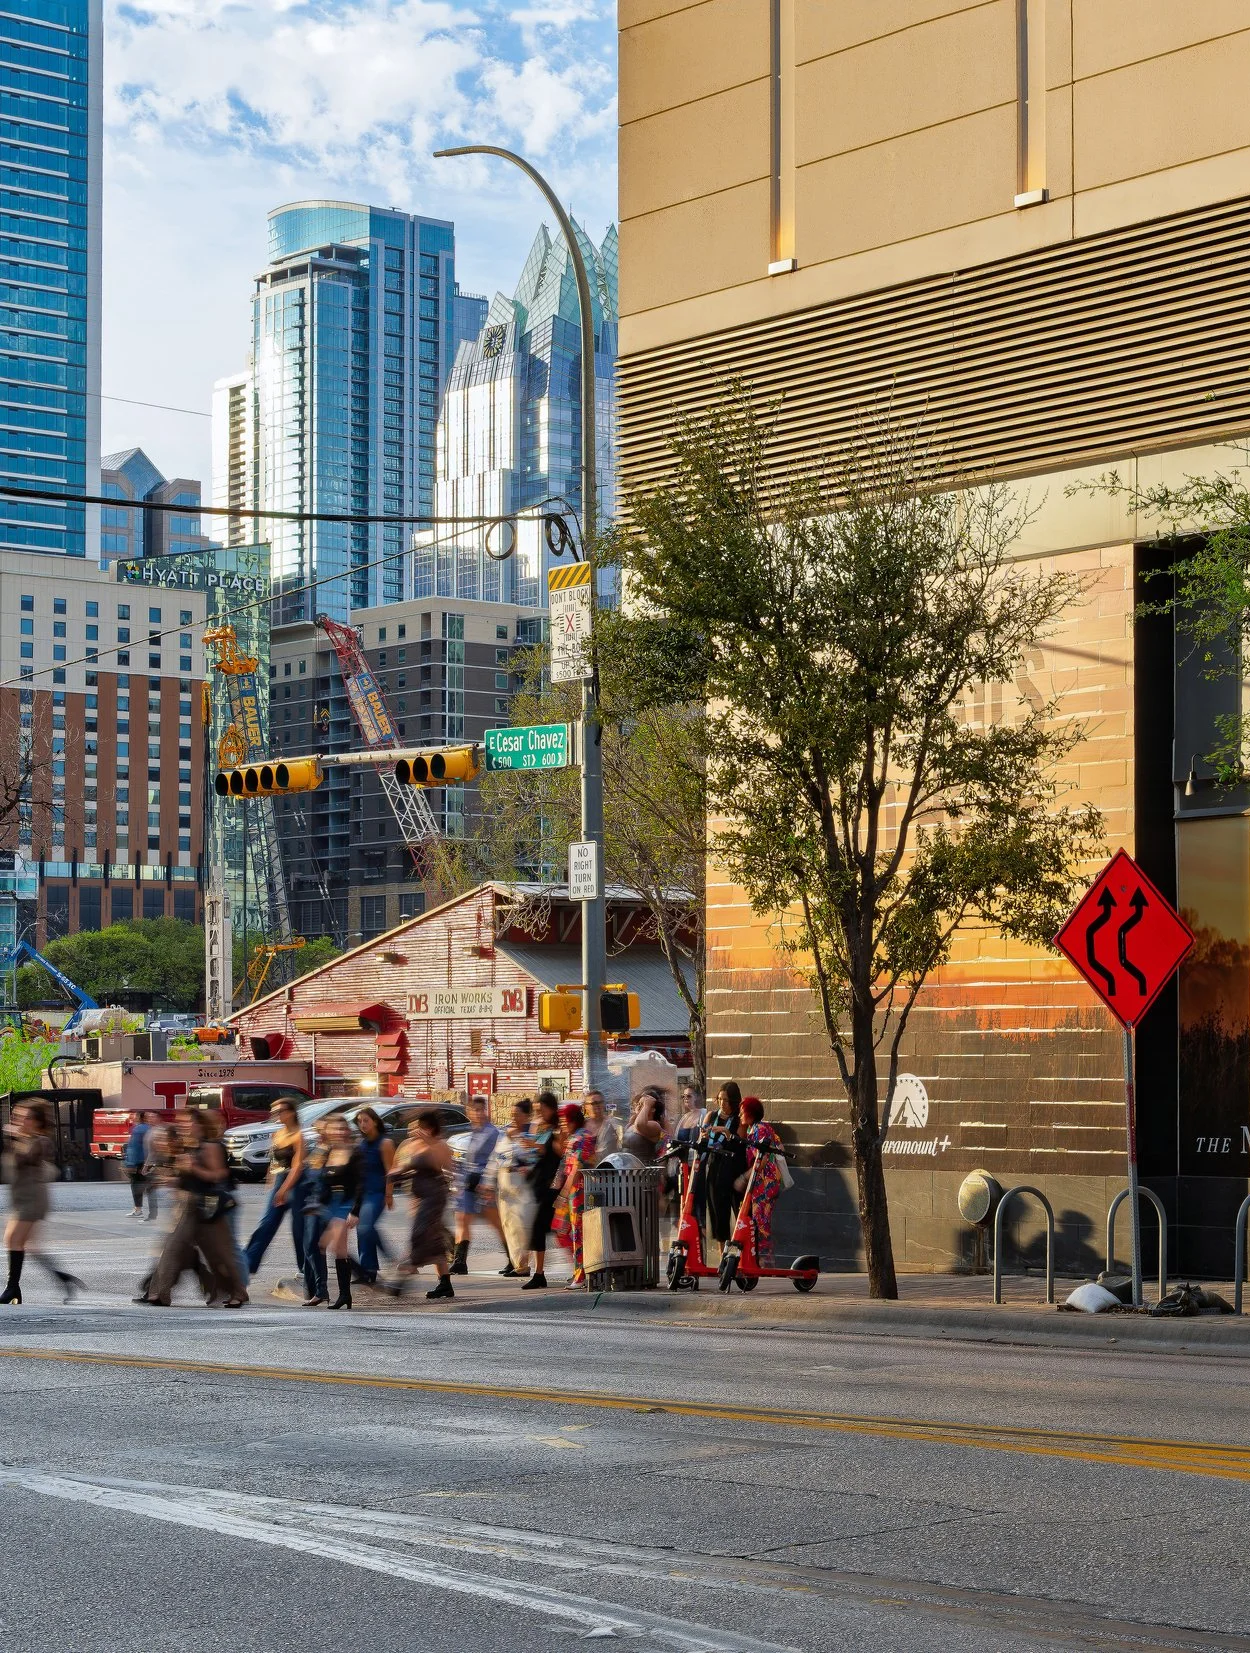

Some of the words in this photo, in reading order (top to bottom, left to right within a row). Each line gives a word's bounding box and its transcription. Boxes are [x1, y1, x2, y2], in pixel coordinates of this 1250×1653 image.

[142, 566, 200, 585] HYATT
[207, 573, 265, 592] PLACE
[568, 588, 589, 602] BLOCK
[561, 660, 570, 670] UP
[556, 669, 572, 679] $500
[366, 691, 392, 737] BAUER
[242, 696, 262, 748] BAUER
[489, 736, 496, 750] E
[496, 732, 524, 753] Cesar
[528, 729, 564, 751] Chavez
[498, 756, 512, 769] 500
[522, 754, 532, 767] ST
[541, 753, 556, 766] 600
[577, 847, 589, 858] NO
[573, 860, 592, 871] RIGHT
[574, 873, 592, 883] TURN
[572, 886, 581, 895] ON
[583, 884, 595, 894] RED
[434, 992, 458, 1005] IRON
[460, 991, 493, 1004] WORKS
[433, 1005, 456, 1015] OFFICIAL
[460, 1004, 477, 1014] TEXAS
[198, 1068, 218, 1078] Since
[218, 1068, 235, 1078] 1978
[882, 1135, 952, 1157] aramount+
[1196, 1136, 1232, 1154] THE
